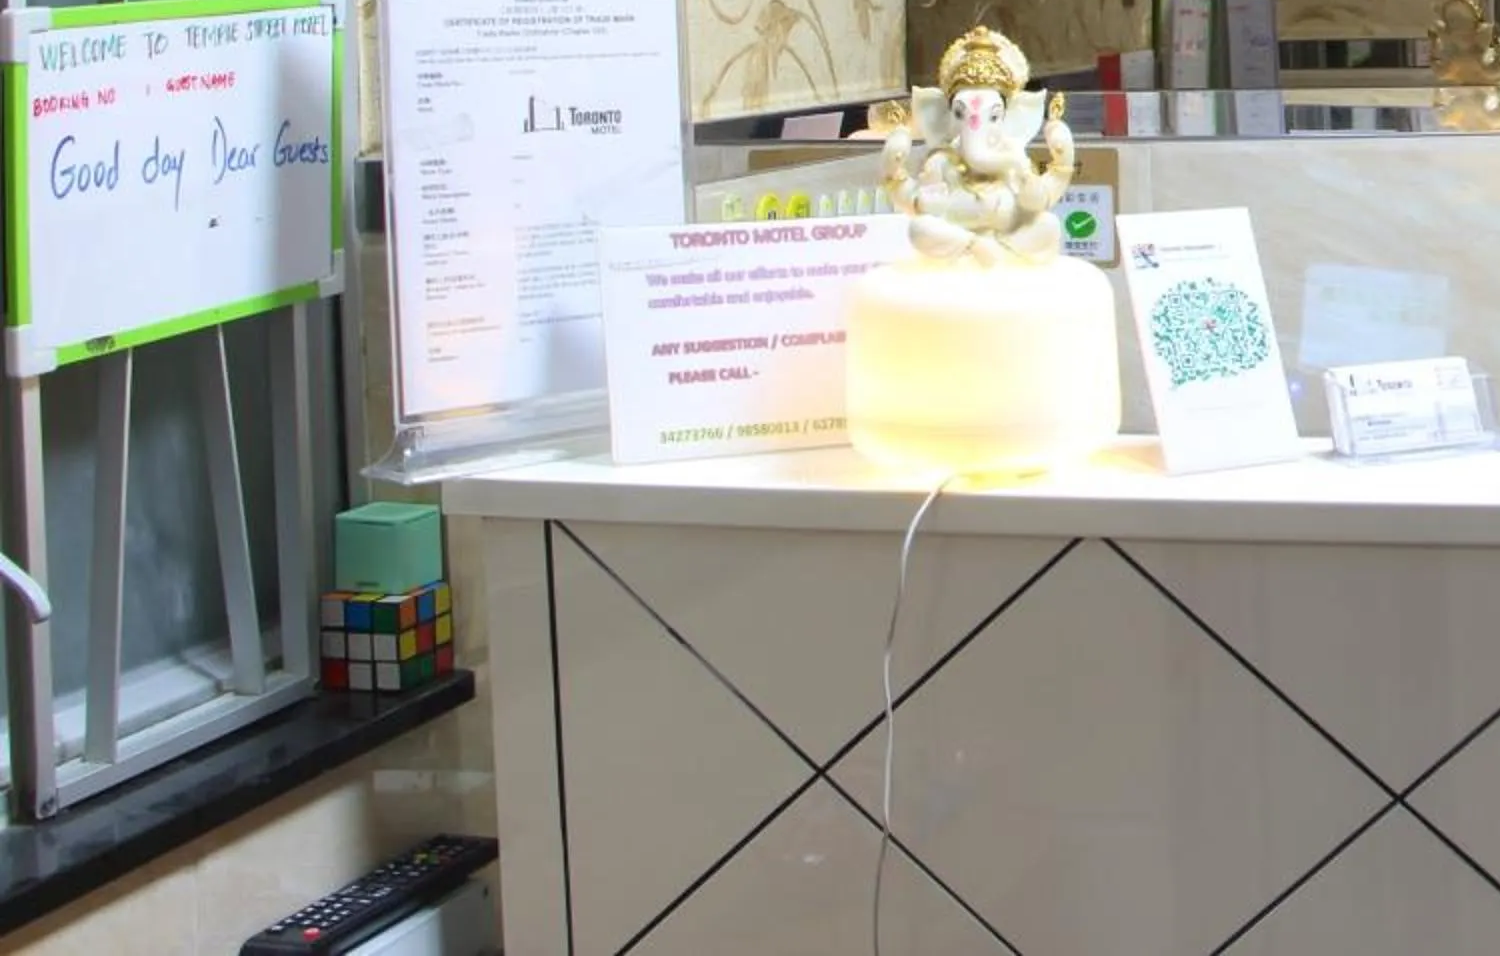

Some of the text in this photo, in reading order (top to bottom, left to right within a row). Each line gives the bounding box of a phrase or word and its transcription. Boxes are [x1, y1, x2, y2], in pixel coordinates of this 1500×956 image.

[39, 33, 127, 72] WELCOME
[143, 31, 169, 60] TO
[33, 89, 90, 117] BOOKING
[97, 87, 116, 105] NO
[51, 116, 329, 213] Good day Dear Guests
[670, 223, 868, 250] TORONTO MOTEL GROUP
[652, 343, 681, 356] ANY
[683, 337, 768, 354] SUGGESTION
[770, 333, 779, 351] /
[669, 369, 716, 385] PLEASE
